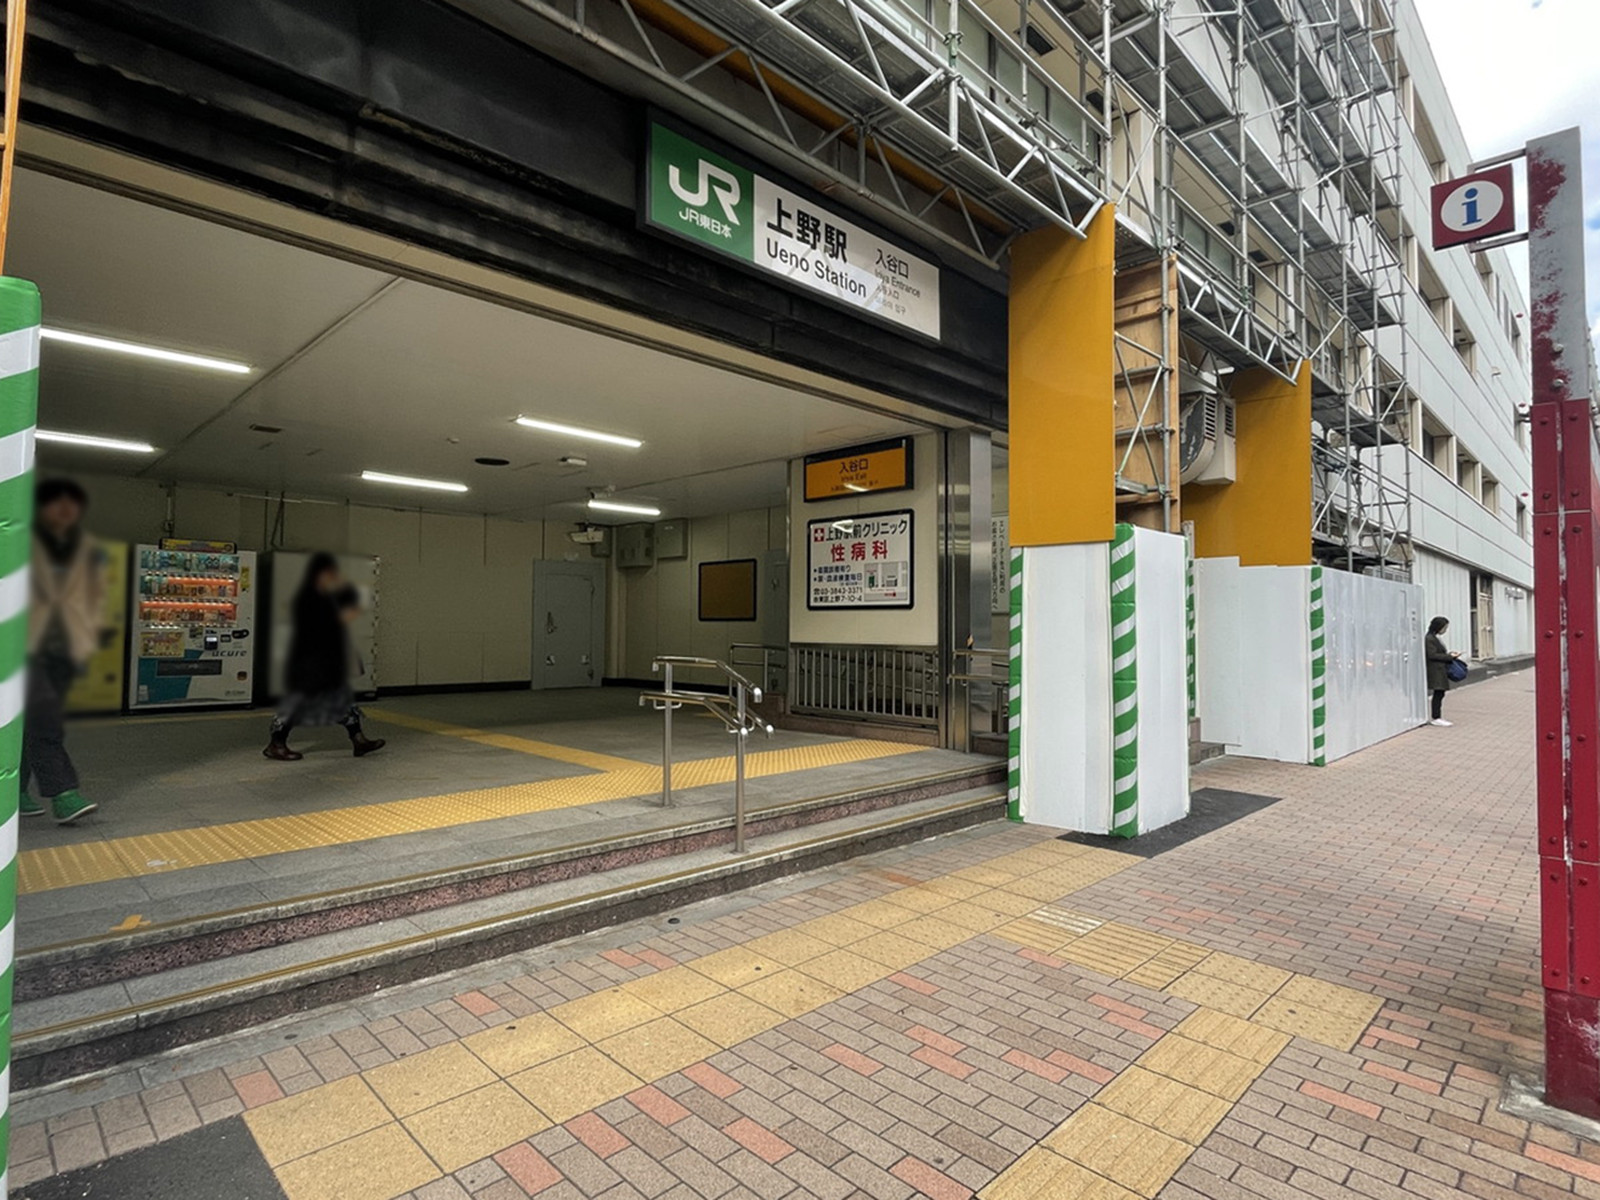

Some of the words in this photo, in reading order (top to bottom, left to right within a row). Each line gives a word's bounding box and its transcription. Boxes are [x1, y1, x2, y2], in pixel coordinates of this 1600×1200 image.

[668, 158, 741, 226] JR
[679, 207, 733, 239] JR東日本
[766, 197, 848, 263] 上野駅
[766, 238, 810, 273] Ueno
[814, 260, 867, 299] Station
[875, 248, 909, 279] 入谷口
[839, 457, 870, 474] 入谷口
[830, 540, 888, 563] 性病科
